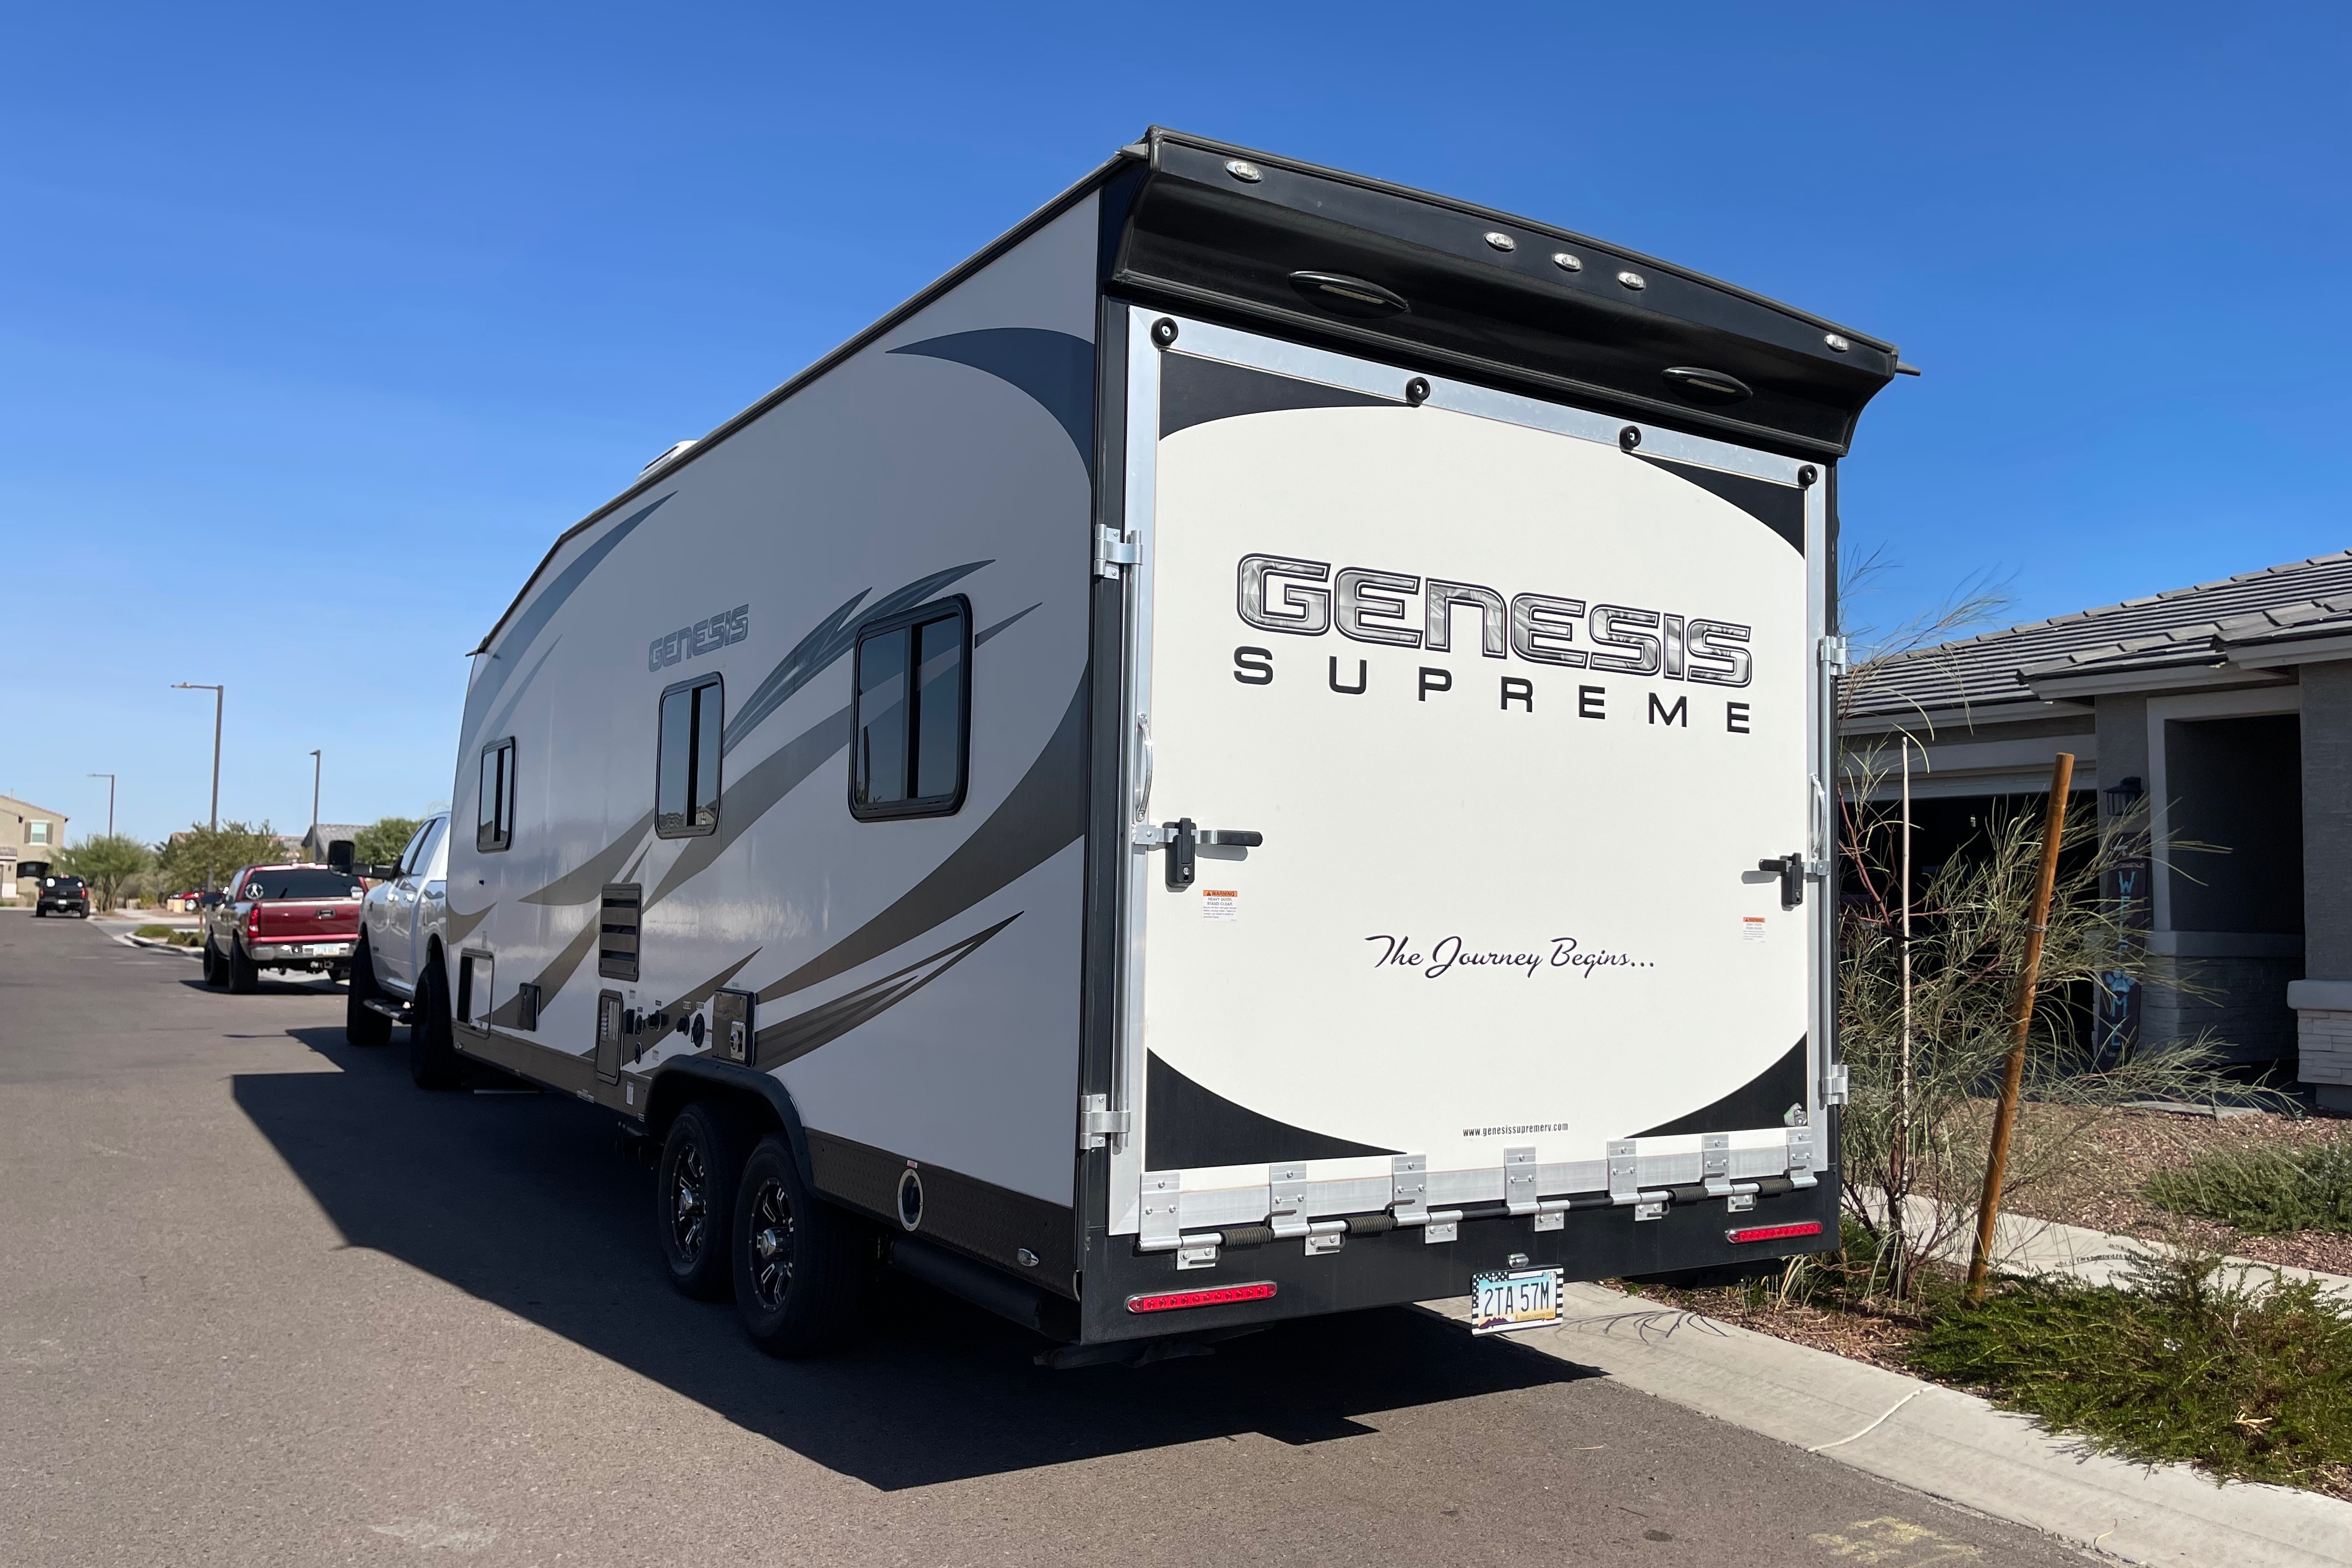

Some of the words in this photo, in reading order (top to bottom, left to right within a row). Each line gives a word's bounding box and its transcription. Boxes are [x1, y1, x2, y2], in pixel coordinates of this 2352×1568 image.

[648, 603, 749, 672] GENESIS
[1237, 552, 1752, 688] GENESIS
[1233, 646, 1750, 734] SUPREME
[1364, 935, 1424, 968] The
[1424, 936, 1543, 979] Journey
[1550, 937, 1654, 979] Begins...
[1462, 1123, 1568, 1137] www.genesissupremerv.com
[1484, 1286, 1514, 1317] 2TA
[1520, 1281, 1549, 1312] 57M
